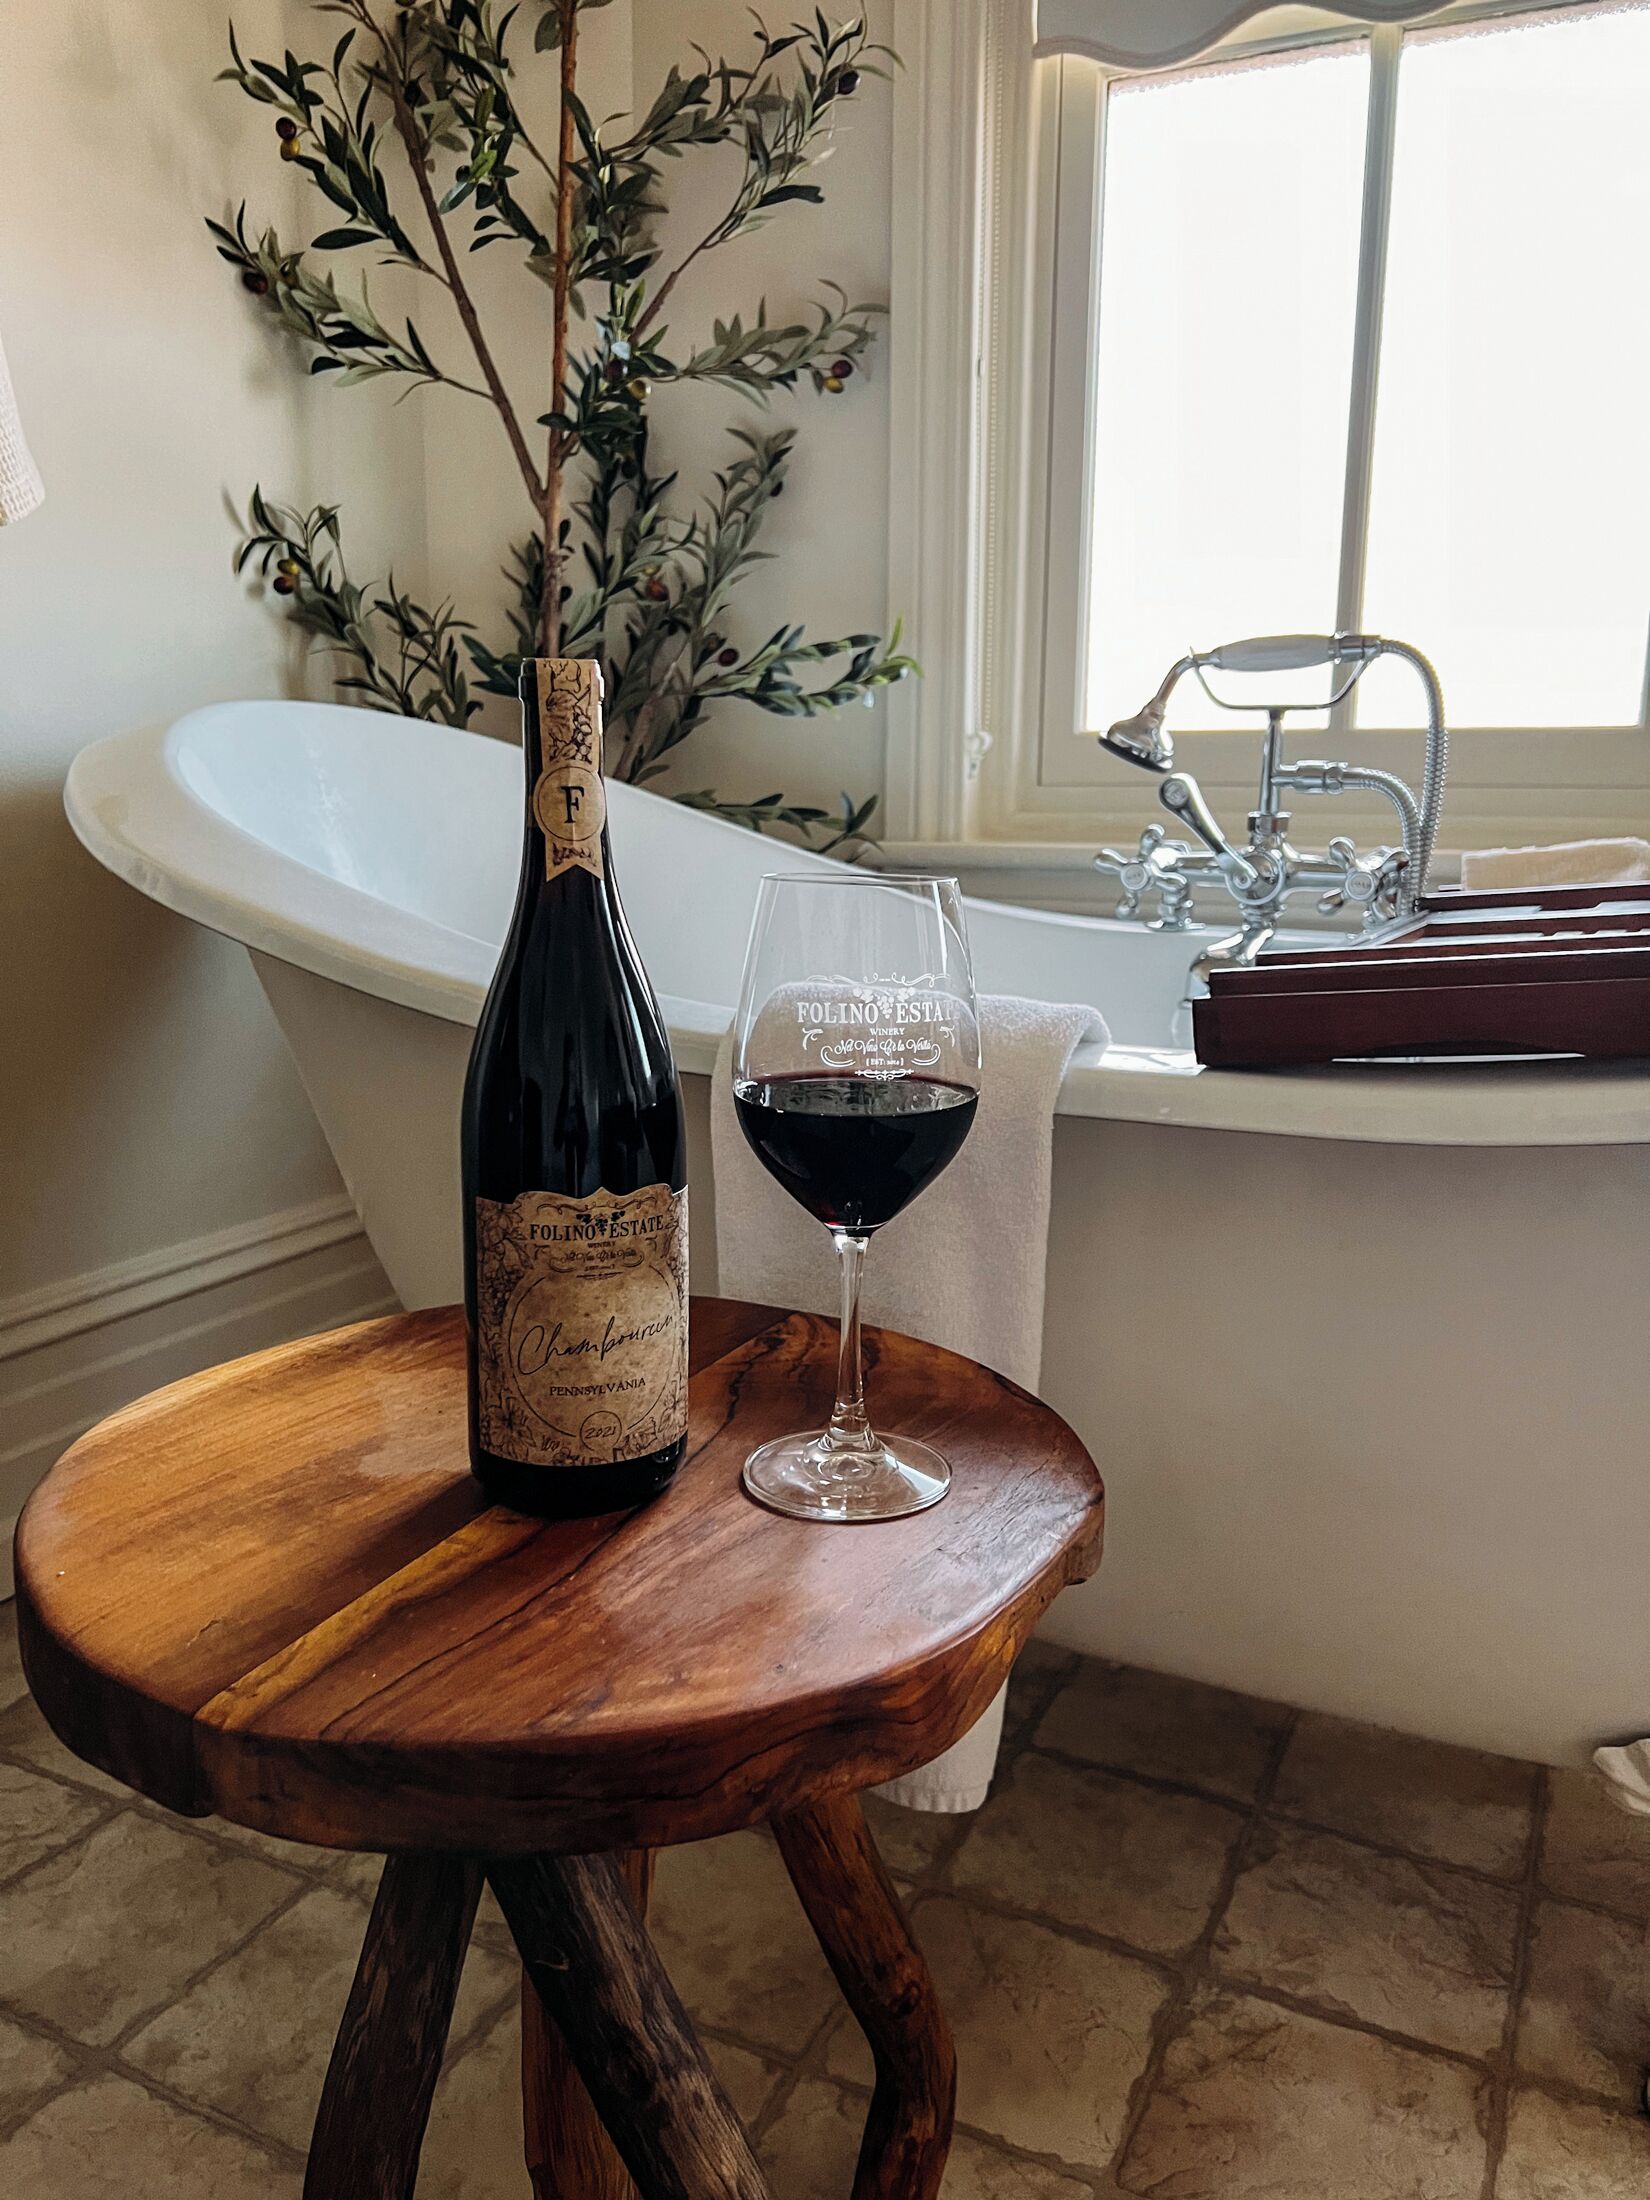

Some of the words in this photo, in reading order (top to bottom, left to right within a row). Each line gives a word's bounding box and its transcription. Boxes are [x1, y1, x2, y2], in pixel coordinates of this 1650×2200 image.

[559, 785, 585, 824] F
[797, 1001, 880, 1024] FOLINO
[869, 1027, 905, 1036] WINERY
[529, 1222, 596, 1242] FOLINO
[609, 1214, 664, 1238] ESTATE
[549, 1377, 647, 1397] PENNSYLVANIA
[584, 1426, 617, 1440] 2021
